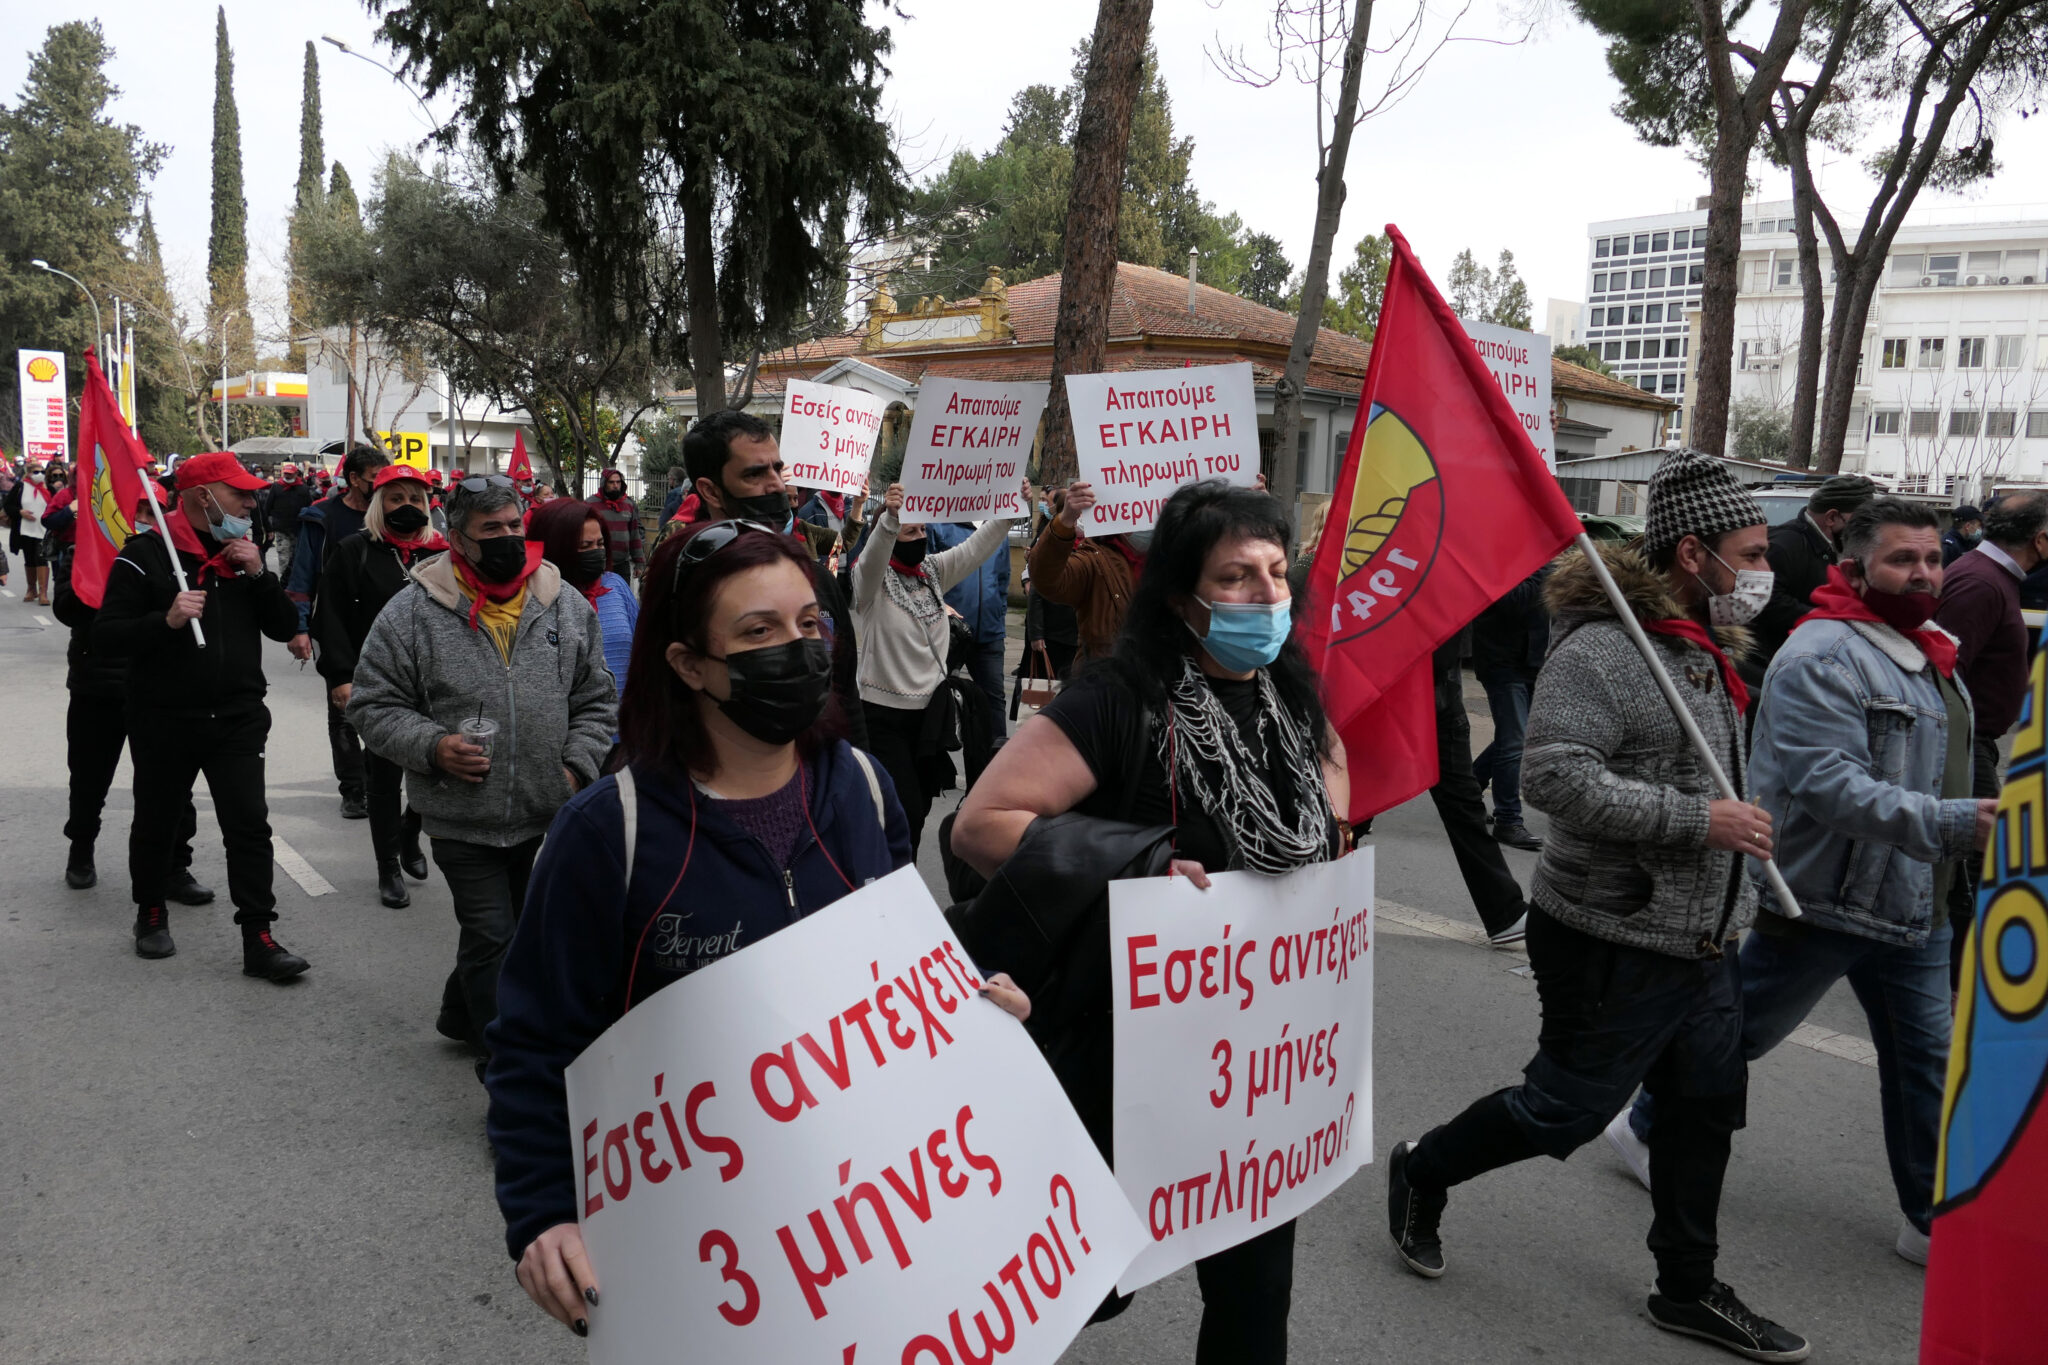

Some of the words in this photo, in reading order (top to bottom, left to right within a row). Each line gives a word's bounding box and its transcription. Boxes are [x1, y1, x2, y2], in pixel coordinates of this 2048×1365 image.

[790, 394, 841, 426] Εσείς
[946, 391, 1021, 421] Απαιτούμε
[1106, 381, 1216, 411] Απαιτούμε
[819, 430, 830, 450] 3
[835, 434, 870, 464] μήνες
[930, 424, 1021, 448] ΕΓΚΑΙΡΗ
[1099, 413, 1231, 448] ΕΓΚΑΙΡΗ
[921, 458, 992, 486] πληρωμή
[995, 461, 1016, 478] του
[1100, 452, 1200, 488] πληρωμή
[1204, 453, 1240, 475] του
[905, 489, 991, 518] ανεργιακού
[994, 491, 1019, 514] μας
[655, 912, 744, 956] Fervent
[1127, 924, 1257, 1011] Εσείς
[1270, 906, 1369, 985] αντέχετε
[582, 1073, 743, 1220] Εσείς
[750, 940, 982, 1122] αντέχετε
[1209, 1038, 1233, 1109] 3
[1246, 1022, 1339, 1118] μήνες
[1148, 1091, 1356, 1242] απλήρωτοι?
[698, 1229, 761, 1327] 3
[775, 1104, 1002, 1321] μήνες
